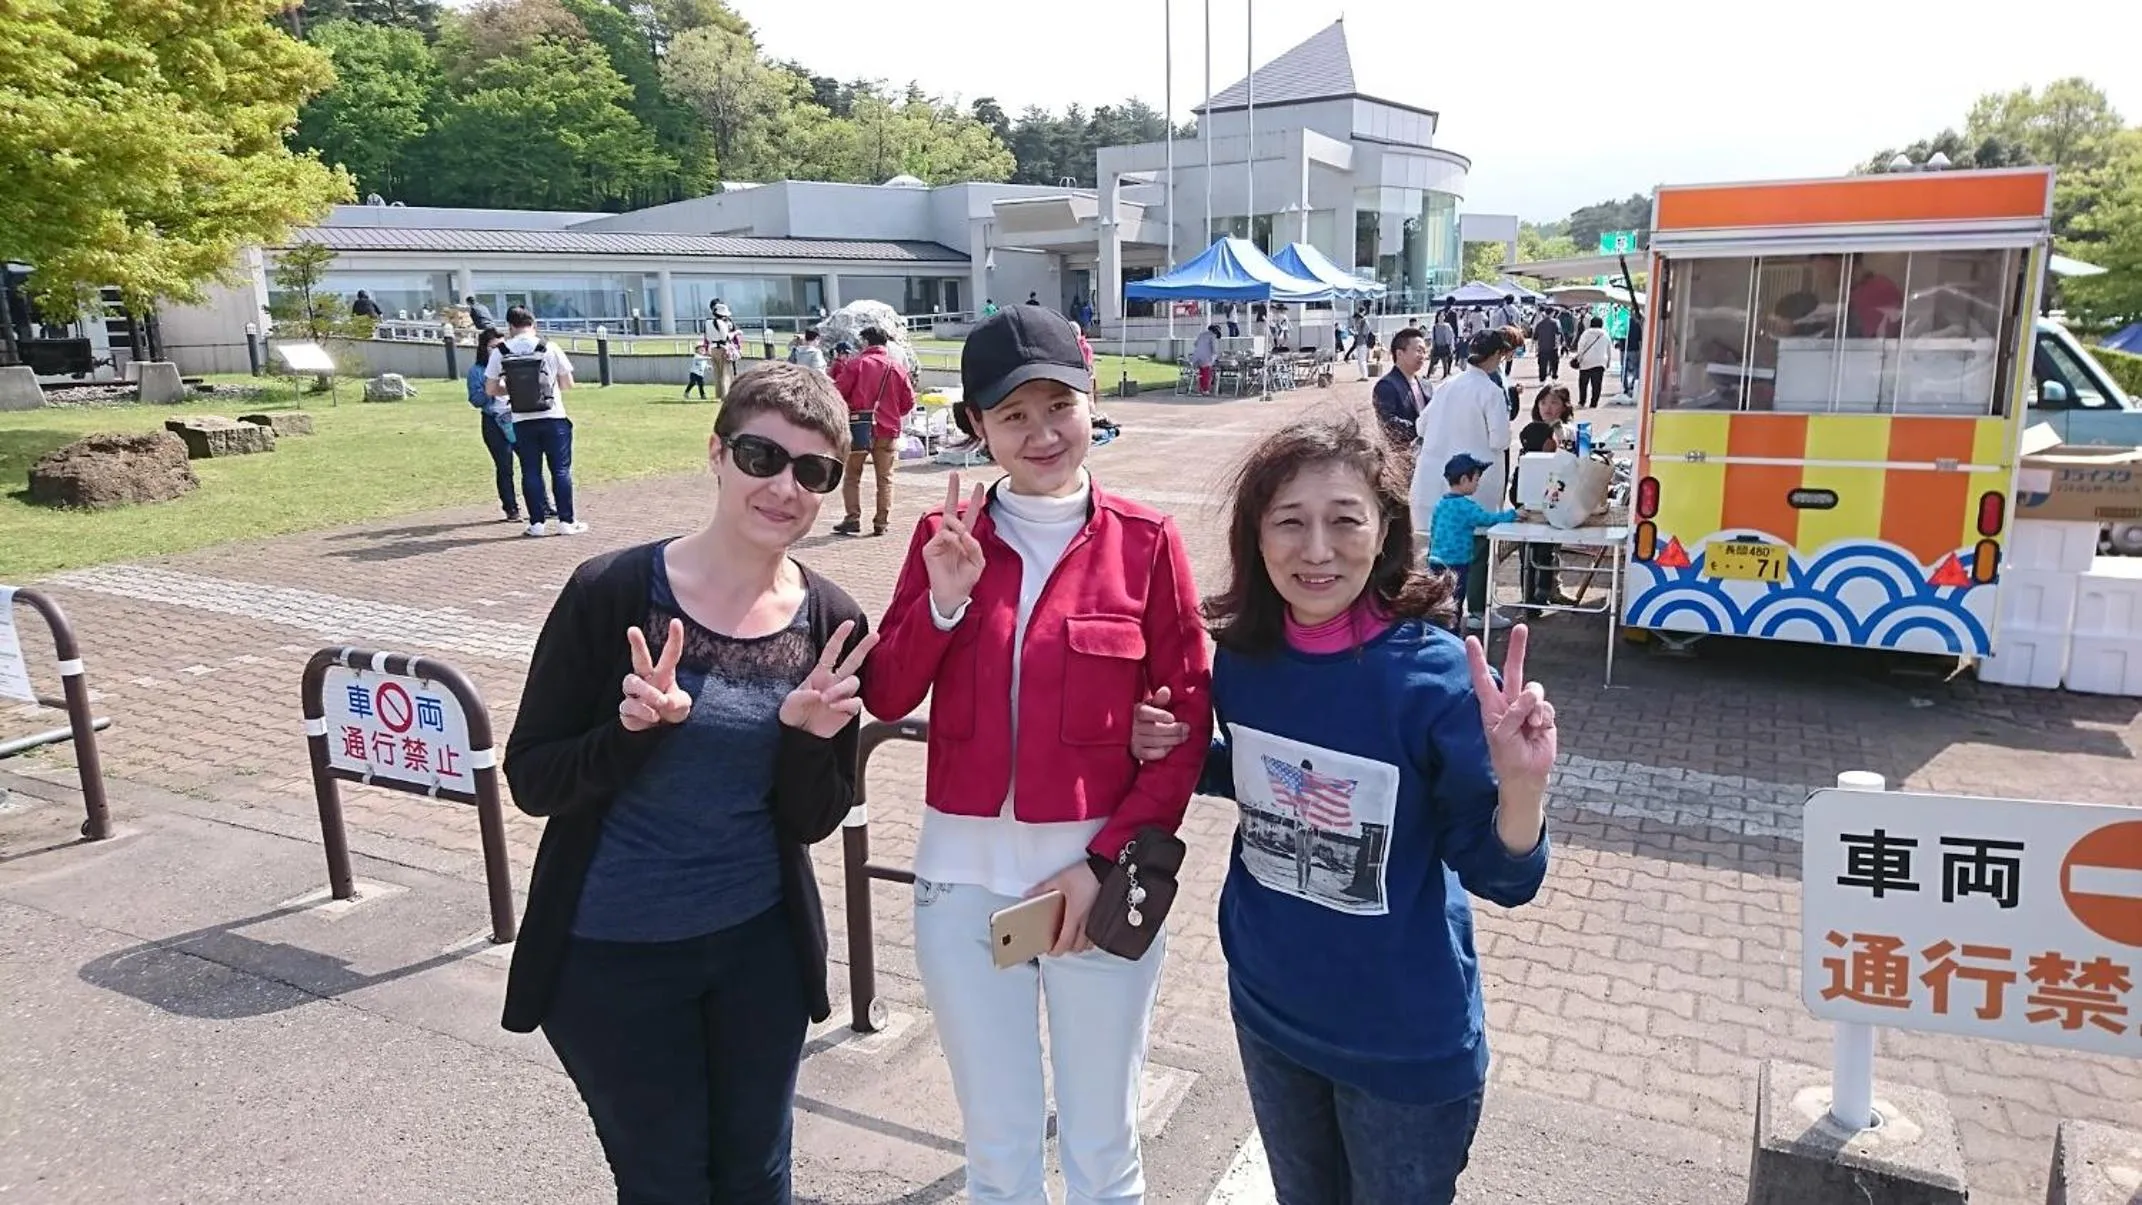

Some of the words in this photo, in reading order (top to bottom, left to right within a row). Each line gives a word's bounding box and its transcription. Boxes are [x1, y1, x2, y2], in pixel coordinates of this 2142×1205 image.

[346, 685, 373, 719] 車
[415, 696, 443, 732] 両
[340, 725, 463, 778] 通行禁止
[1837, 829, 2024, 909] 車両
[1820, 930, 2142, 1037] 通行禁
